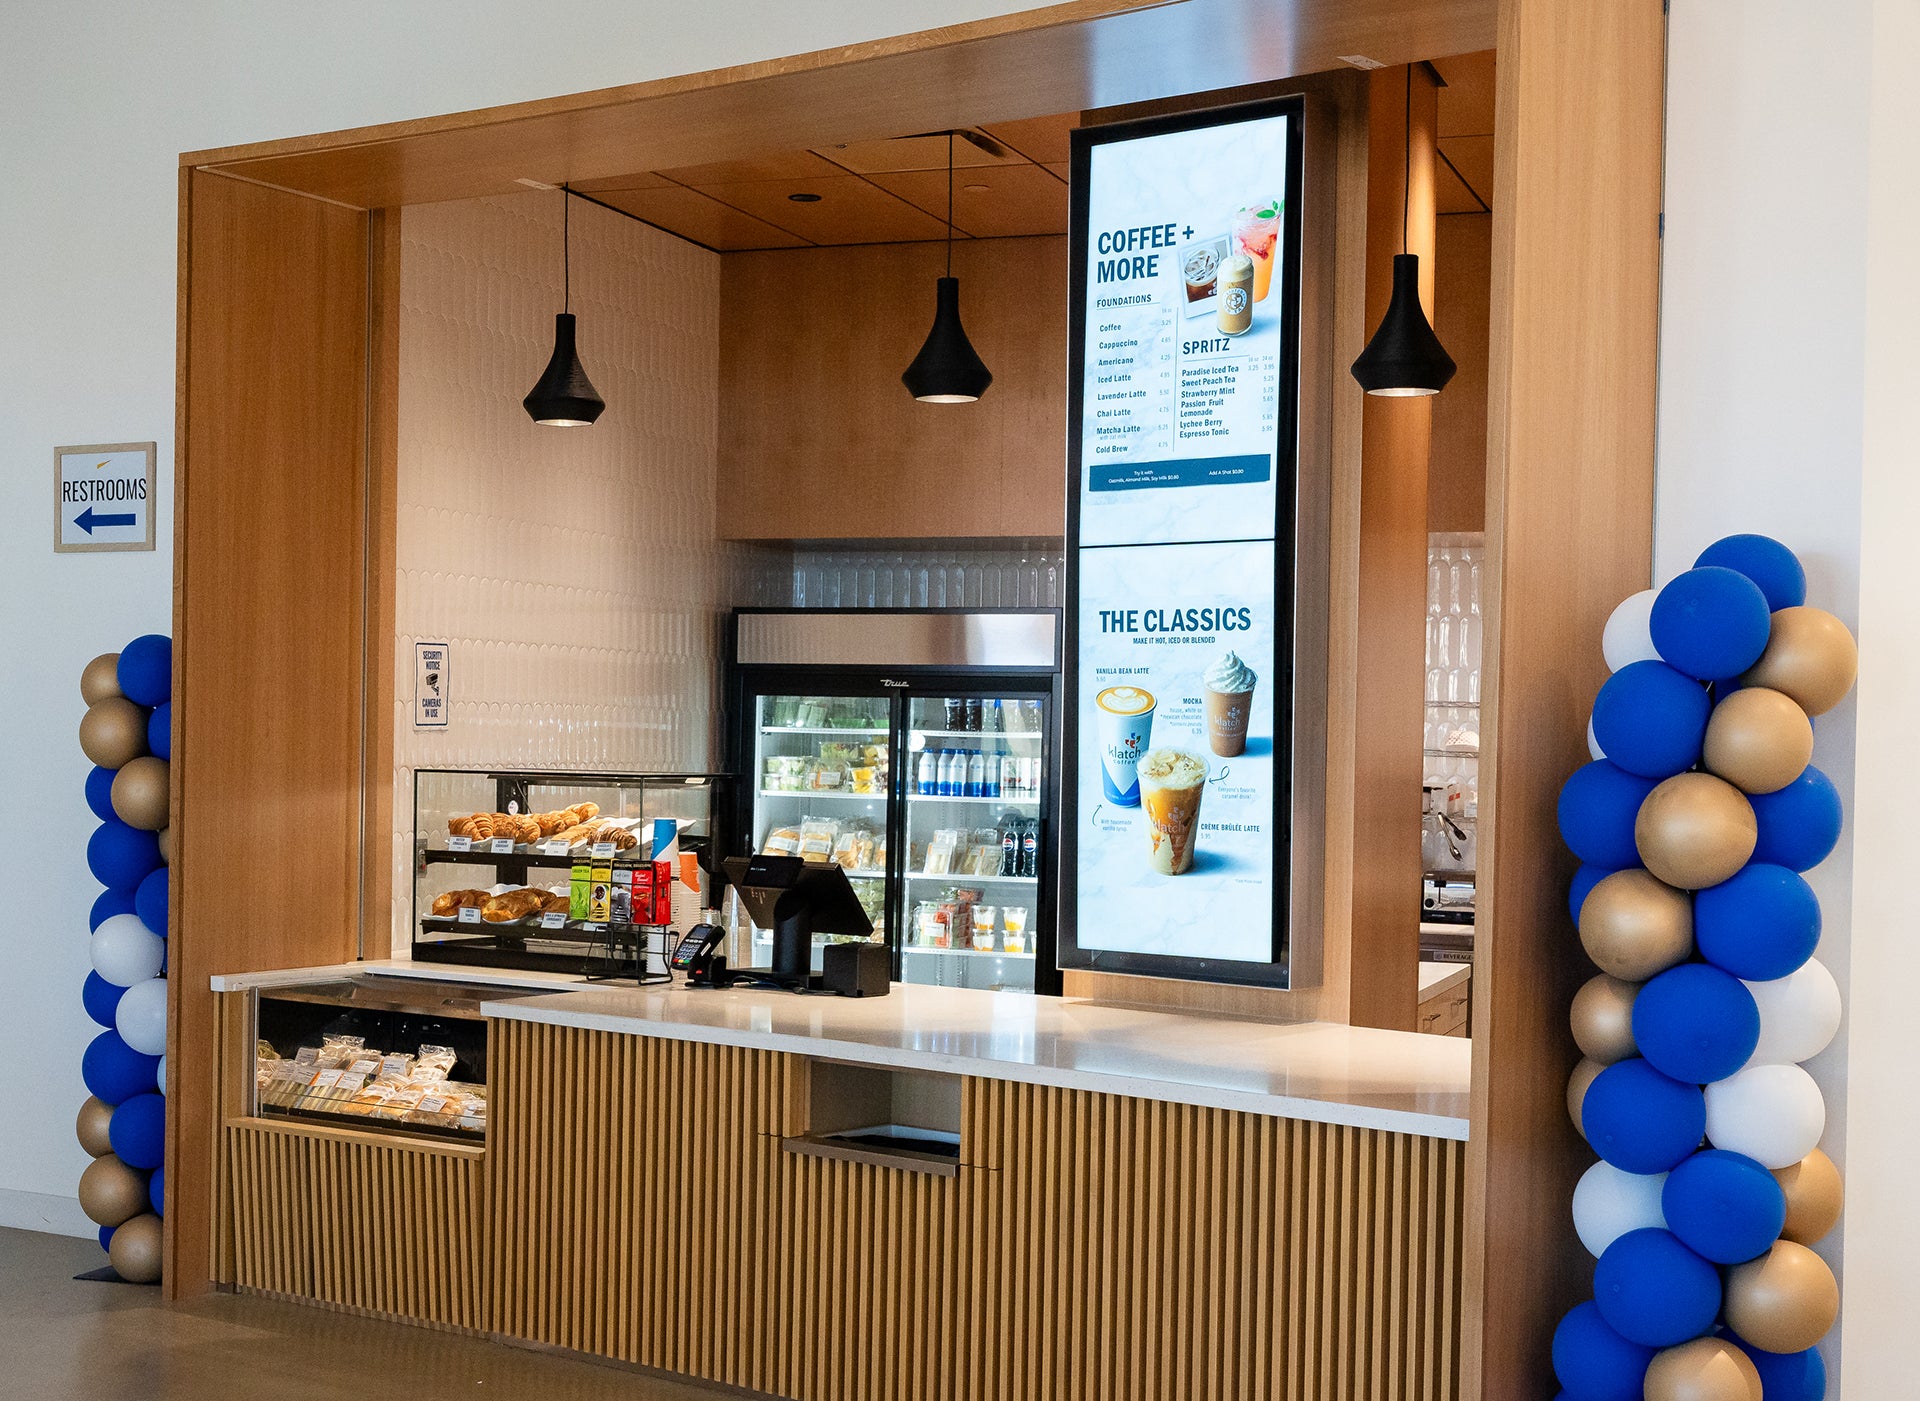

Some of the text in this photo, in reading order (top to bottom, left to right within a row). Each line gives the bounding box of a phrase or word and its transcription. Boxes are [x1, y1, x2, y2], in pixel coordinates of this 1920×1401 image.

[1097, 223, 1194, 255] COFFEE +
[1097, 254, 1159, 283] MORE
[1096, 294, 1152, 308] FOUNDATIONS
[1100, 324, 1121, 332] Coffee
[1099, 339, 1138, 350] Cappuccino
[1182, 338, 1230, 354] SPRITZ
[1098, 358, 1134, 366] Americano
[1182, 368, 1210, 376] Paradise
[1212, 366, 1226, 374] Iced
[1227, 365, 1239, 373] Tea
[1114, 374, 1132, 382] Latte
[1181, 379, 1201, 387] Sweet
[1203, 377, 1222, 385] Peach
[1097, 392, 1127, 401] Lavender
[1129, 390, 1146, 398] Latte
[1181, 389, 1217, 398] Strawberry
[1181, 400, 1206, 408] Passion
[1097, 410, 1112, 418] Chai
[1180, 409, 1213, 417] Lemonade
[1180, 420, 1202, 429] Lychee
[1204, 419, 1222, 427] Berry
[1123, 425, 1140, 433] Latte
[1180, 430, 1210, 439] Espresso
[1212, 428, 1229, 436] Tonic
[63, 478, 146, 502] RESTROOMS
[1099, 607, 1252, 632] THE CLASSICS
[1133, 637, 1147, 645] MAKE
[1155, 637, 1167, 645] HOT,
[423, 651, 442, 660] SECURITY
[426, 661, 440, 670] NOTICE
[880, 679, 910, 687] True
[422, 698, 441, 707] CAMERAS
[425, 709, 438, 717] IN USE
[1214, 714, 1240, 727] klatch
[1108, 744, 1141, 759] klatch
[1201, 822, 1219, 831] CRÈME
[1221, 823, 1242, 831] BRÛLÉE
